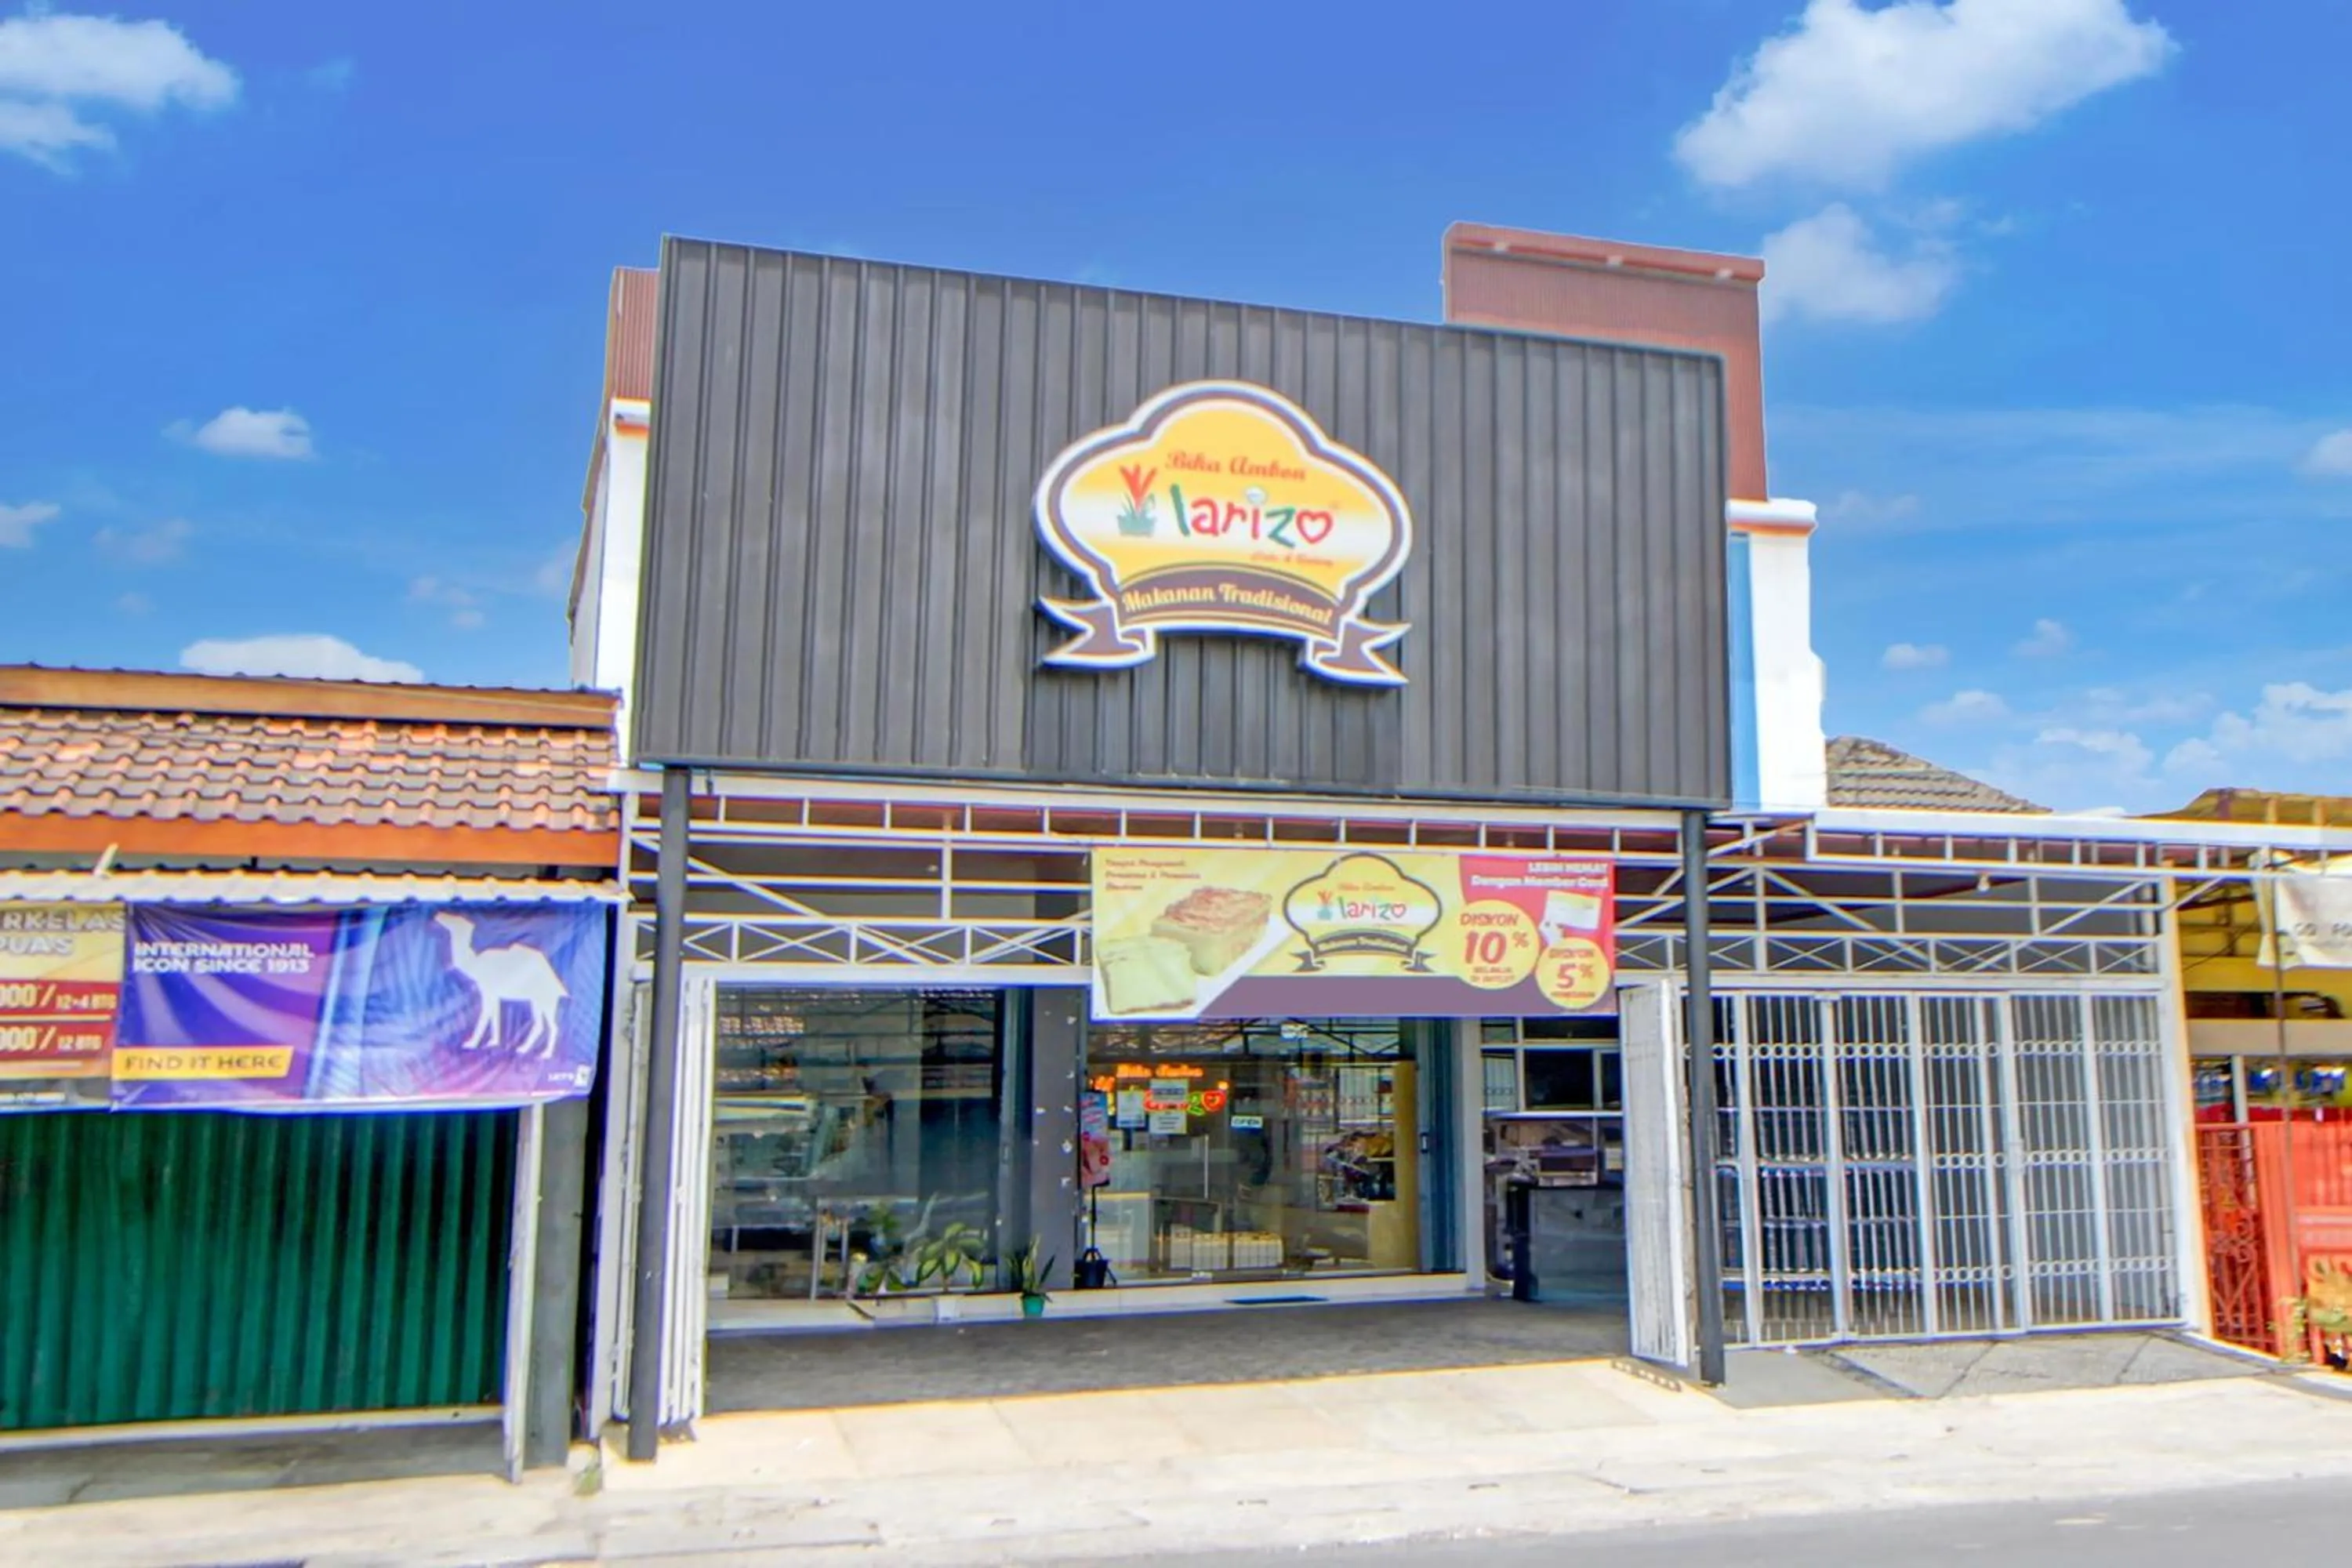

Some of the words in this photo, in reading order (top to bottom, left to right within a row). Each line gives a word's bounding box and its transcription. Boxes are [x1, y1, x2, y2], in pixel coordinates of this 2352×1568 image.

[1165, 449, 1220, 473] Bika
[1229, 456, 1306, 481] Ambon
[1123, 586, 1216, 612] Makanan
[1218, 583, 1333, 625] Tradisional
[1461, 913, 1519, 926] DISKON
[134, 942, 314, 958] INTERNATIONAL
[133, 958, 189, 972] ICON
[195, 958, 261, 973] SINCE
[268, 958, 310, 972] 1913
[125, 1055, 183, 1070] FIND
[191, 1054, 212, 1069] IT
[218, 1054, 283, 1069] HERE
